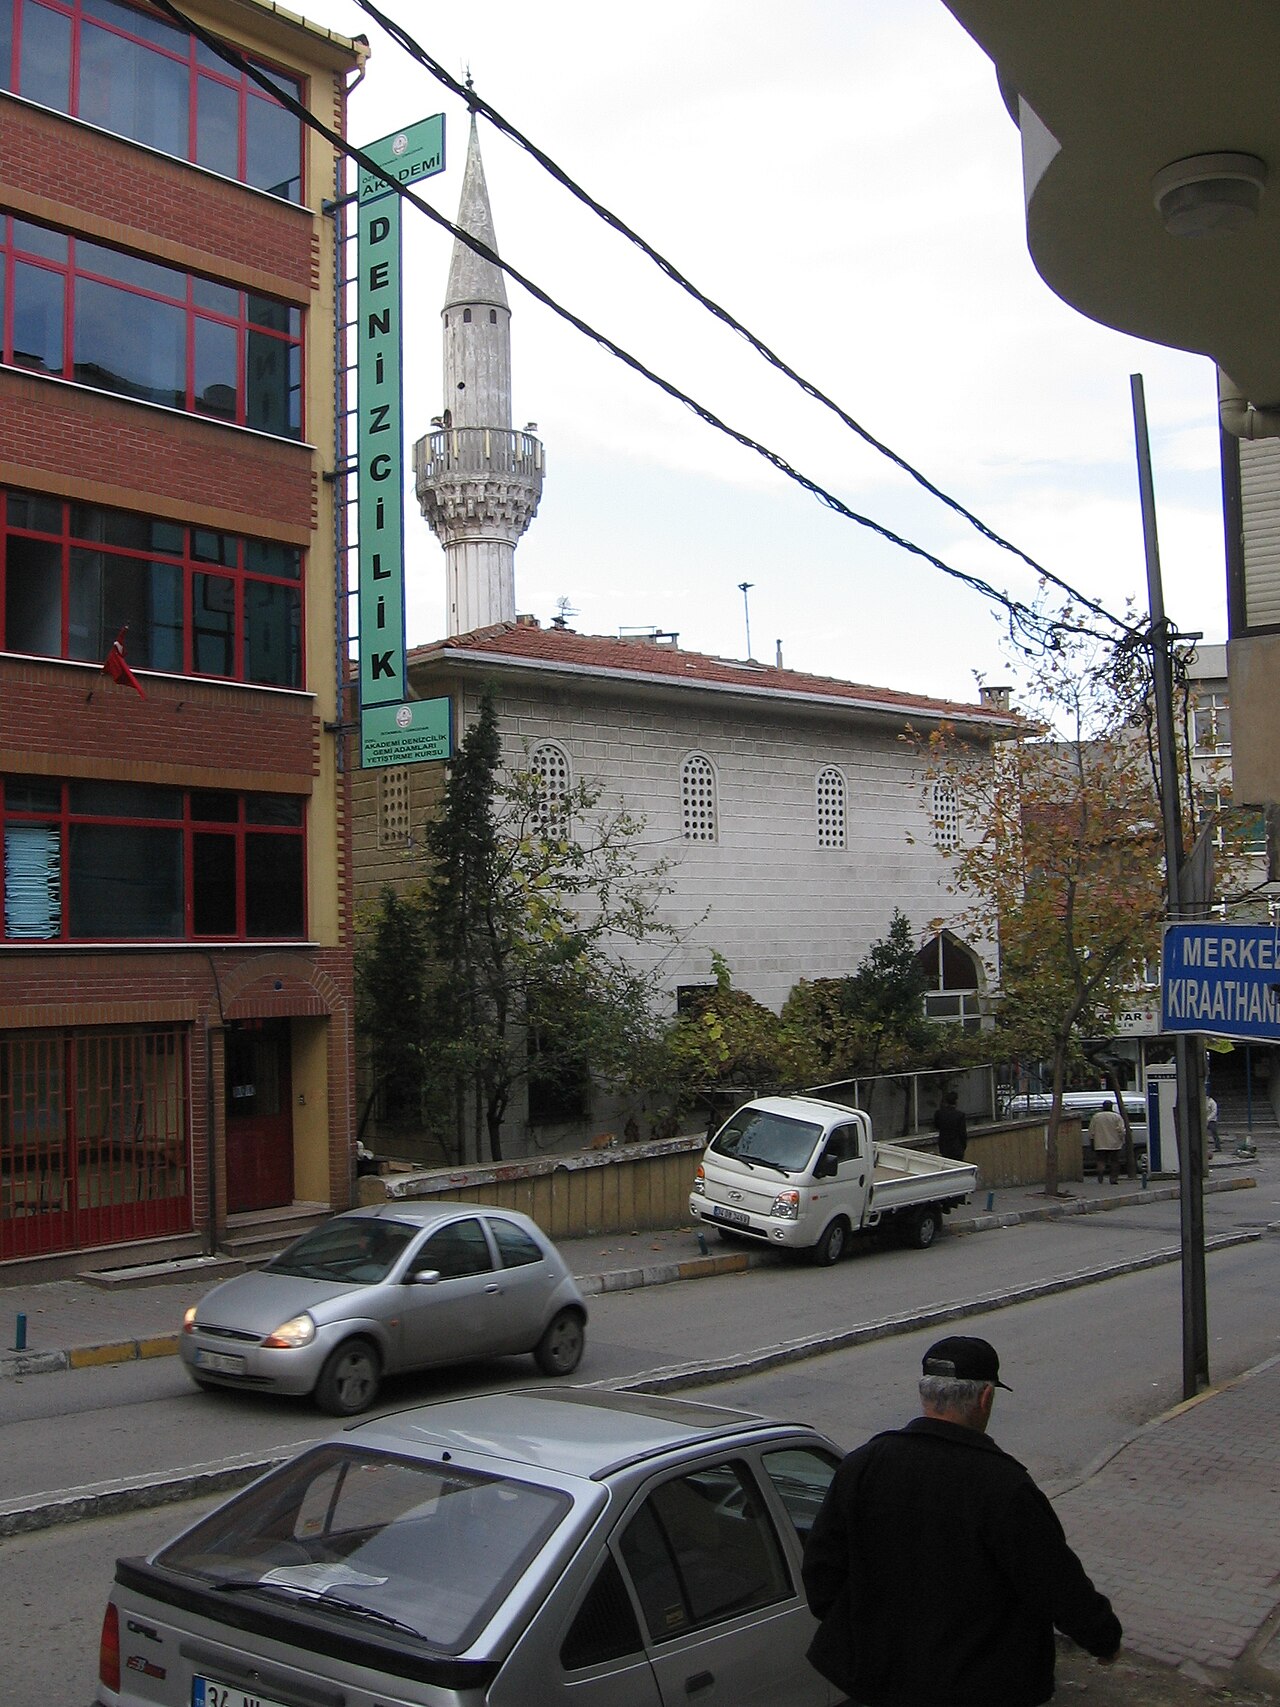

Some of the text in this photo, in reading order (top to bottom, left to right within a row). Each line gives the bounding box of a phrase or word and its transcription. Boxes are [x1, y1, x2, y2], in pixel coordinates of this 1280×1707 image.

[362, 152, 441, 197] AKDEMİ
[369, 216, 396, 681] DENİZCİLİK
[415, 749, 443, 758] KURSU
